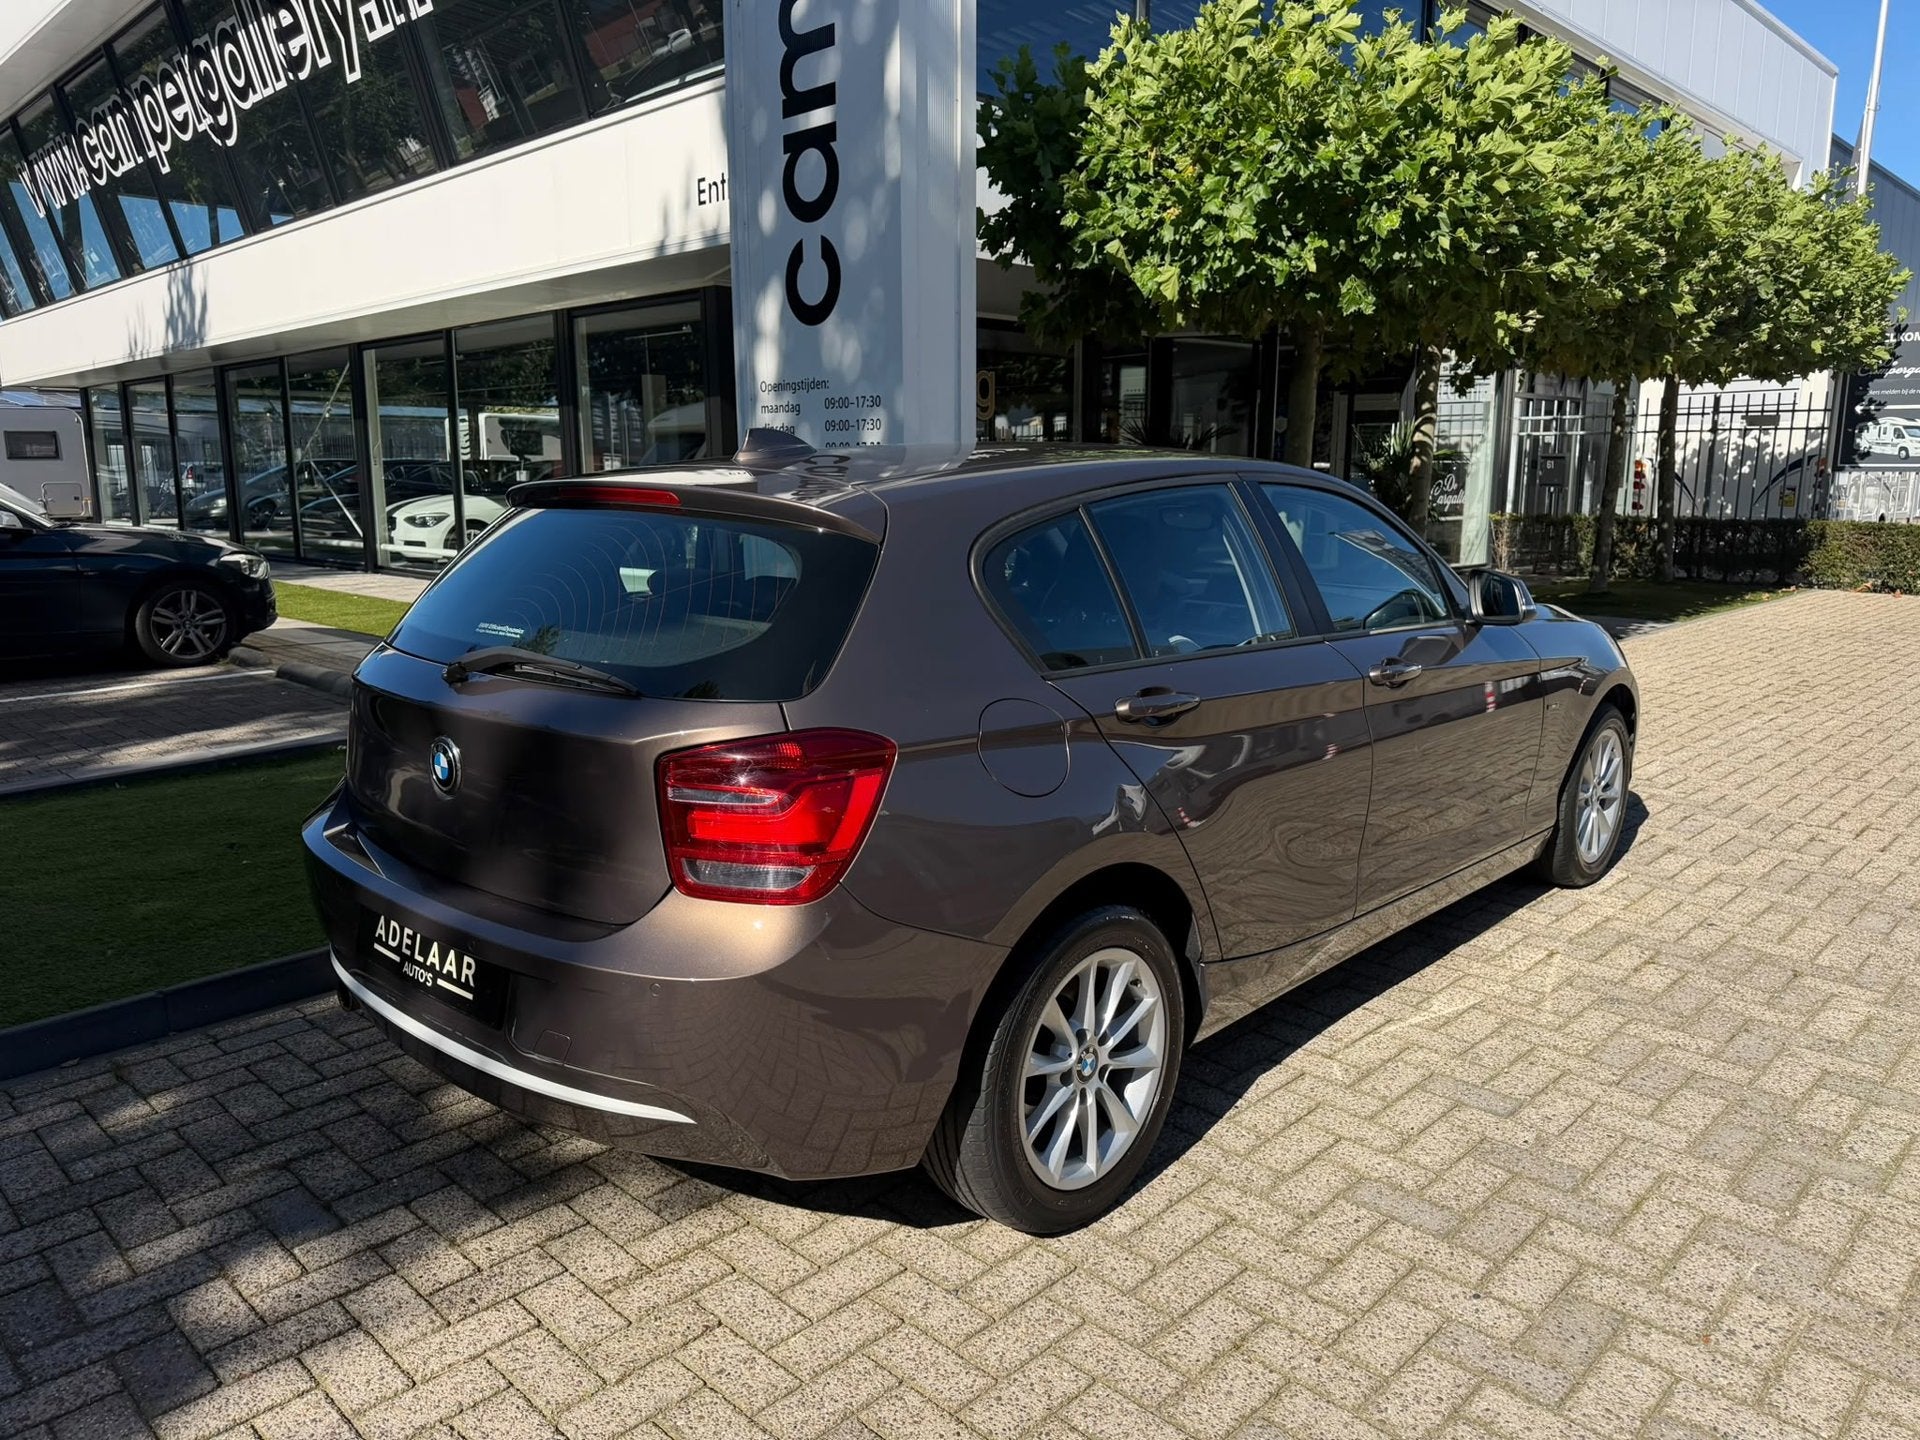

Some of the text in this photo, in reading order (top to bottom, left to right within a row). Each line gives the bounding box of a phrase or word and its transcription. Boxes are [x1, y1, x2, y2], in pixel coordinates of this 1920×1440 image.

[697, 172, 727, 206] Ent
[760, 378, 830, 395] Openingstijden:
[761, 402, 800, 415] maandag
[1546, 461, 1555, 469] 61
[375, 915, 476, 988] ADELAAR
[402, 961, 433, 987] AUTO'S
